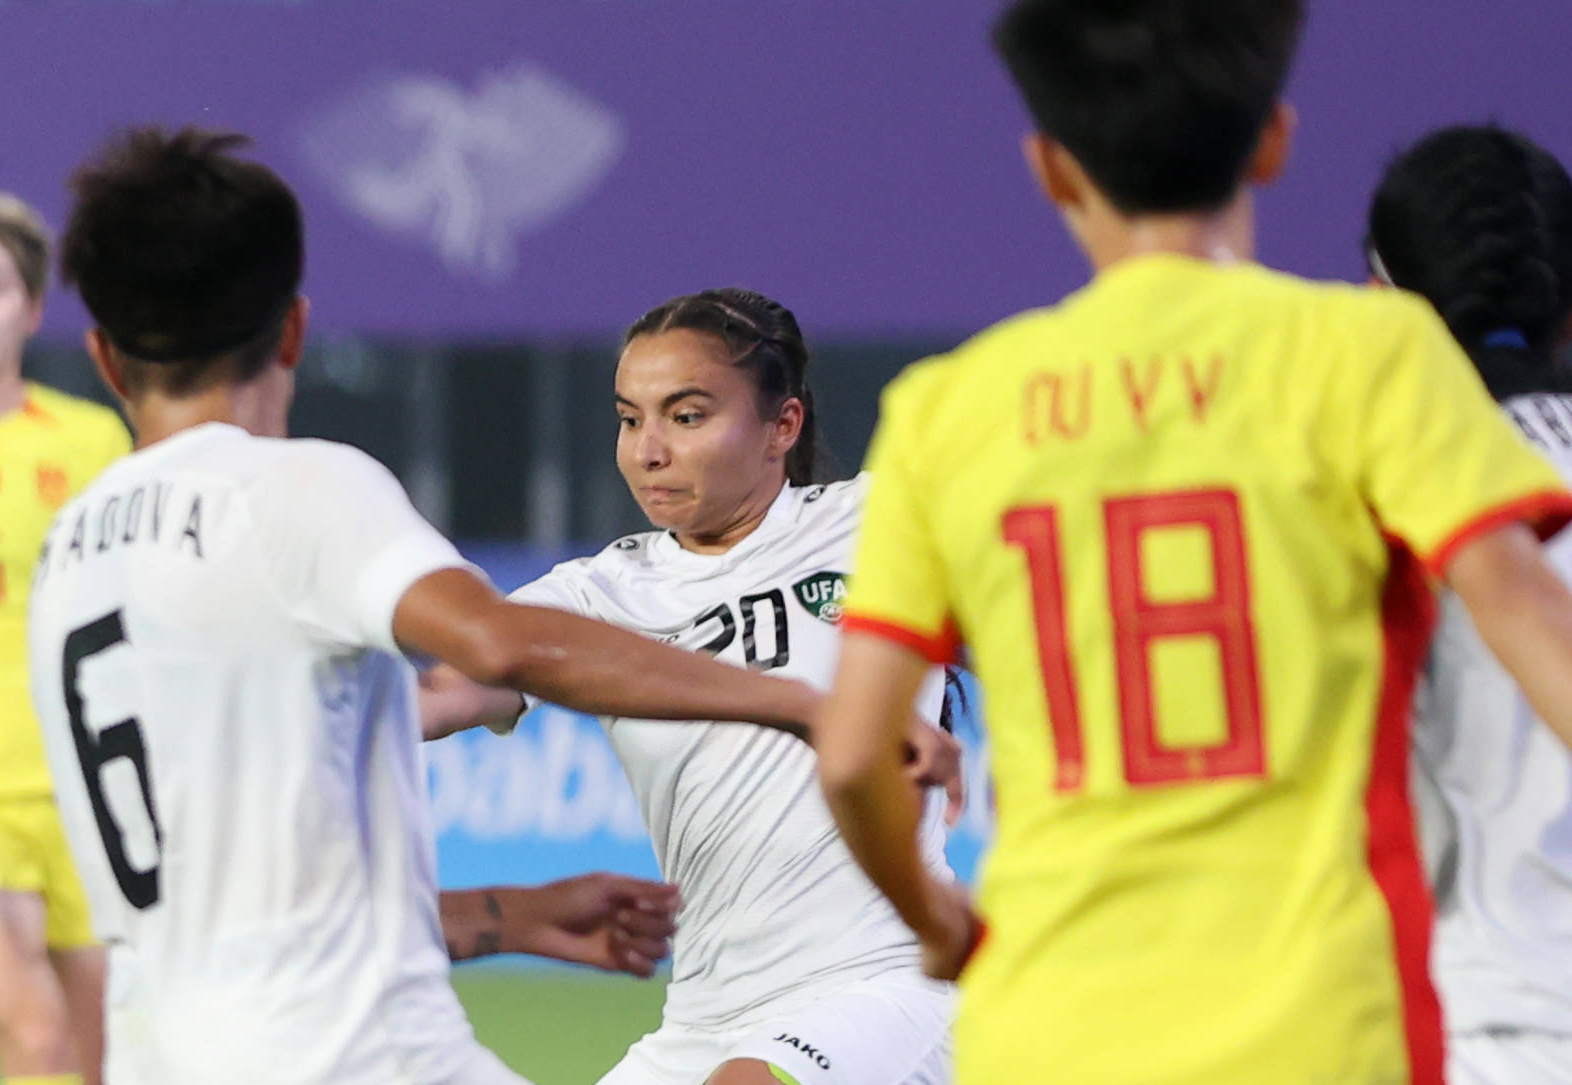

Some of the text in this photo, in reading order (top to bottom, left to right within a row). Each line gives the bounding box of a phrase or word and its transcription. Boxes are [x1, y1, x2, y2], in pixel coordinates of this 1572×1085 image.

[62, 606, 165, 910] 6
[1002, 484, 1266, 793] 18
[772, 1033, 831, 1070] JAKO
